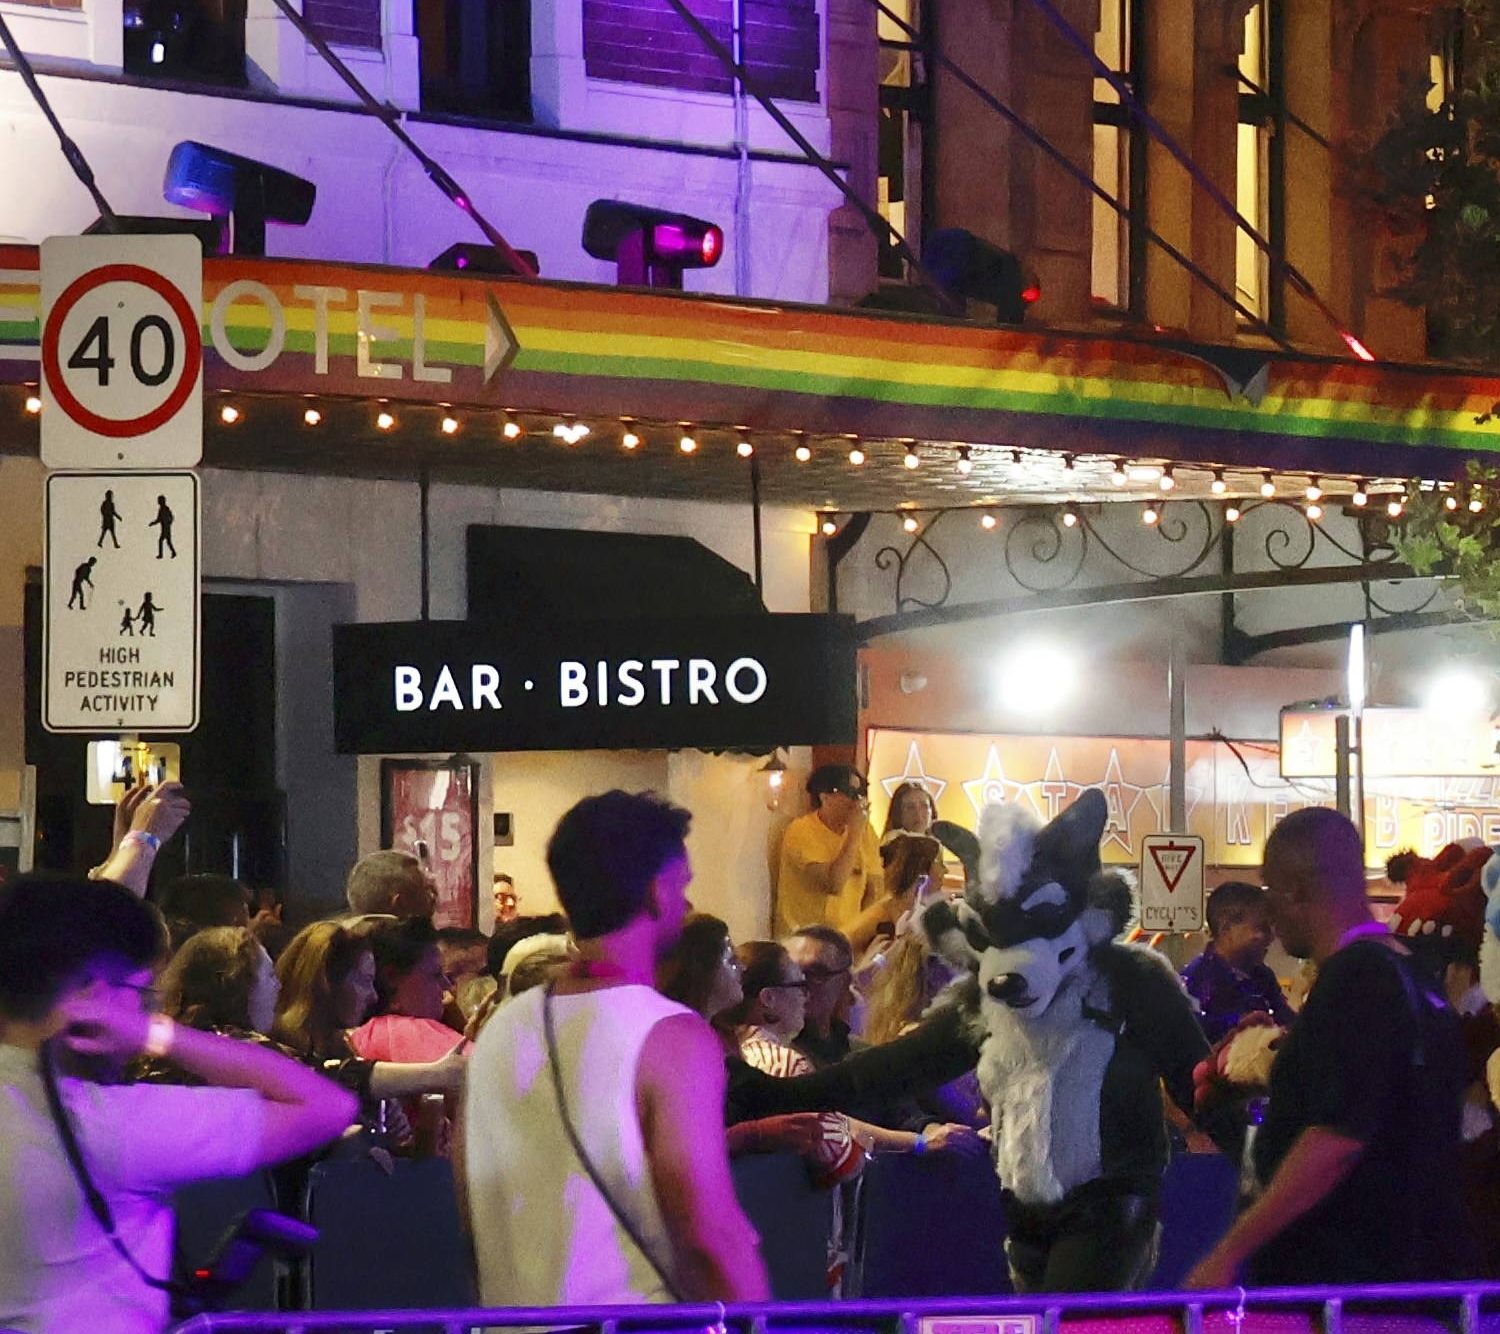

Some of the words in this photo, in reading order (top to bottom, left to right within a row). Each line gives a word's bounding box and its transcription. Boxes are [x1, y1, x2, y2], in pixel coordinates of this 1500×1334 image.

[211, 279, 452, 383] OTEL
[68, 315, 175, 387] 40
[99, 647, 140, 663] HIGH
[65, 671, 174, 688] PEDESTRIAN
[394, 664, 503, 711] BAR
[560, 657, 768, 707] BISTRO
[80, 695, 158, 711] ACTIVITY
